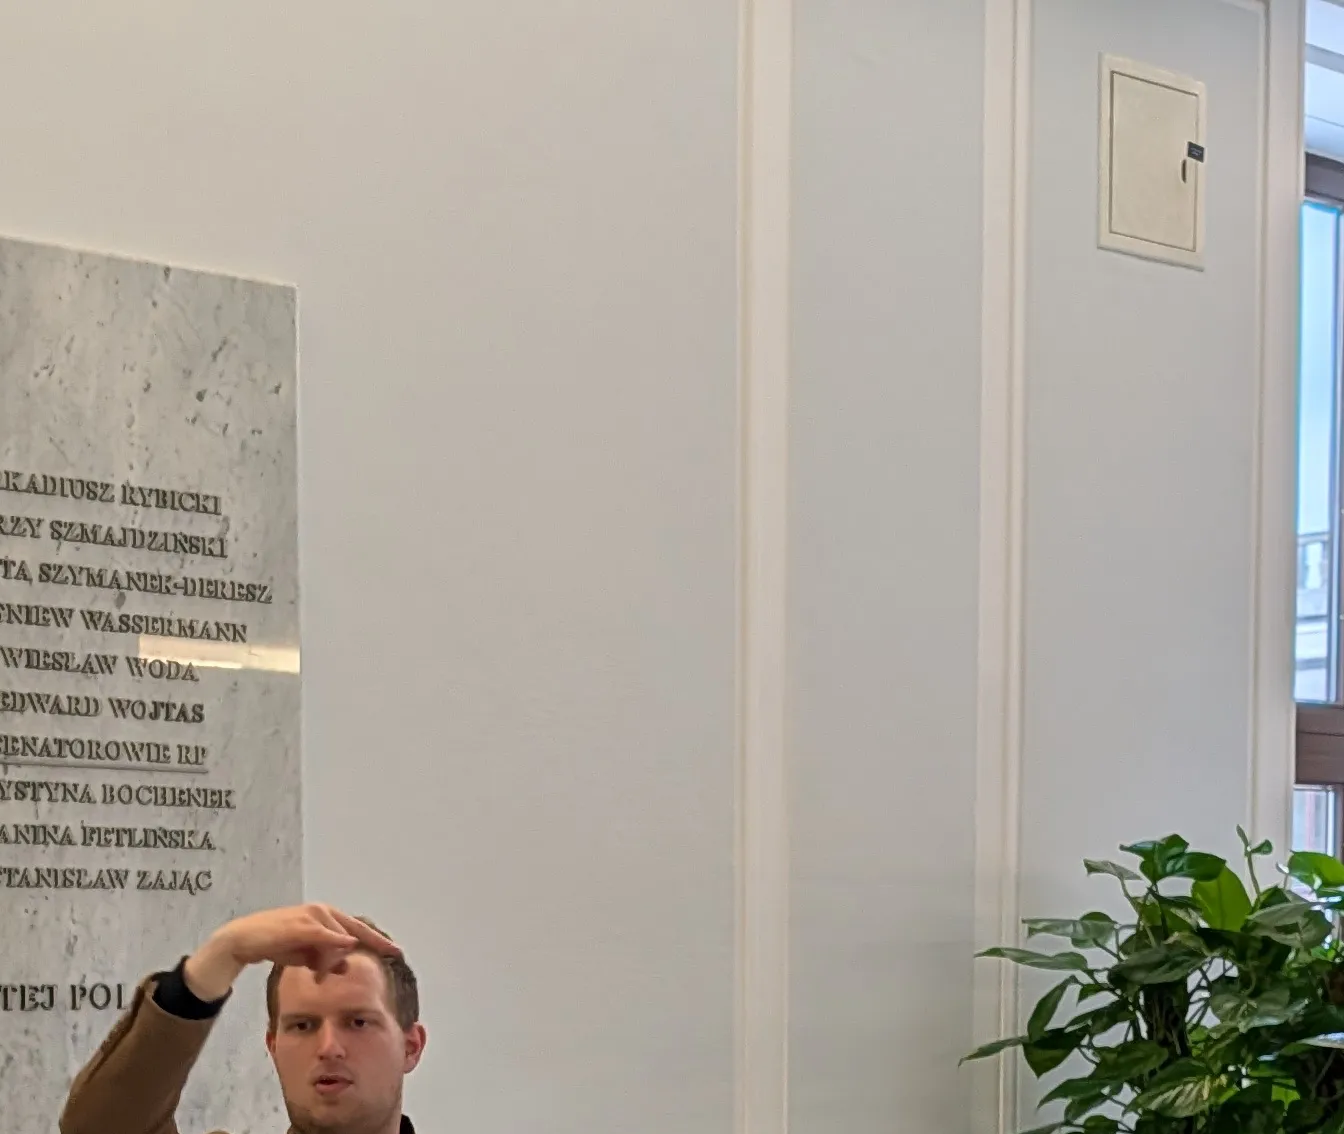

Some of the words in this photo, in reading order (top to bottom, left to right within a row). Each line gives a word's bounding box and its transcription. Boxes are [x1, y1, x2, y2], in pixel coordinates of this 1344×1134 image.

[121, 485, 222, 515] RYBICKI
[50, 520, 228, 558] SZMAJDZIŃSKI
[38, 562, 272, 604] SZYMANEK-DERESZ
[80, 608, 248, 643] WASSERMANN
[0, 645, 118, 676] WIESŁAW
[125, 656, 199, 682] WODA
[108, 697, 205, 723] WOJTAS
[177, 744, 207, 765] RP
[102, 784, 236, 809] BOCHENEK
[82, 824, 216, 850] FETLIŃSKA
[136, 869, 212, 894] ZAJĄC
